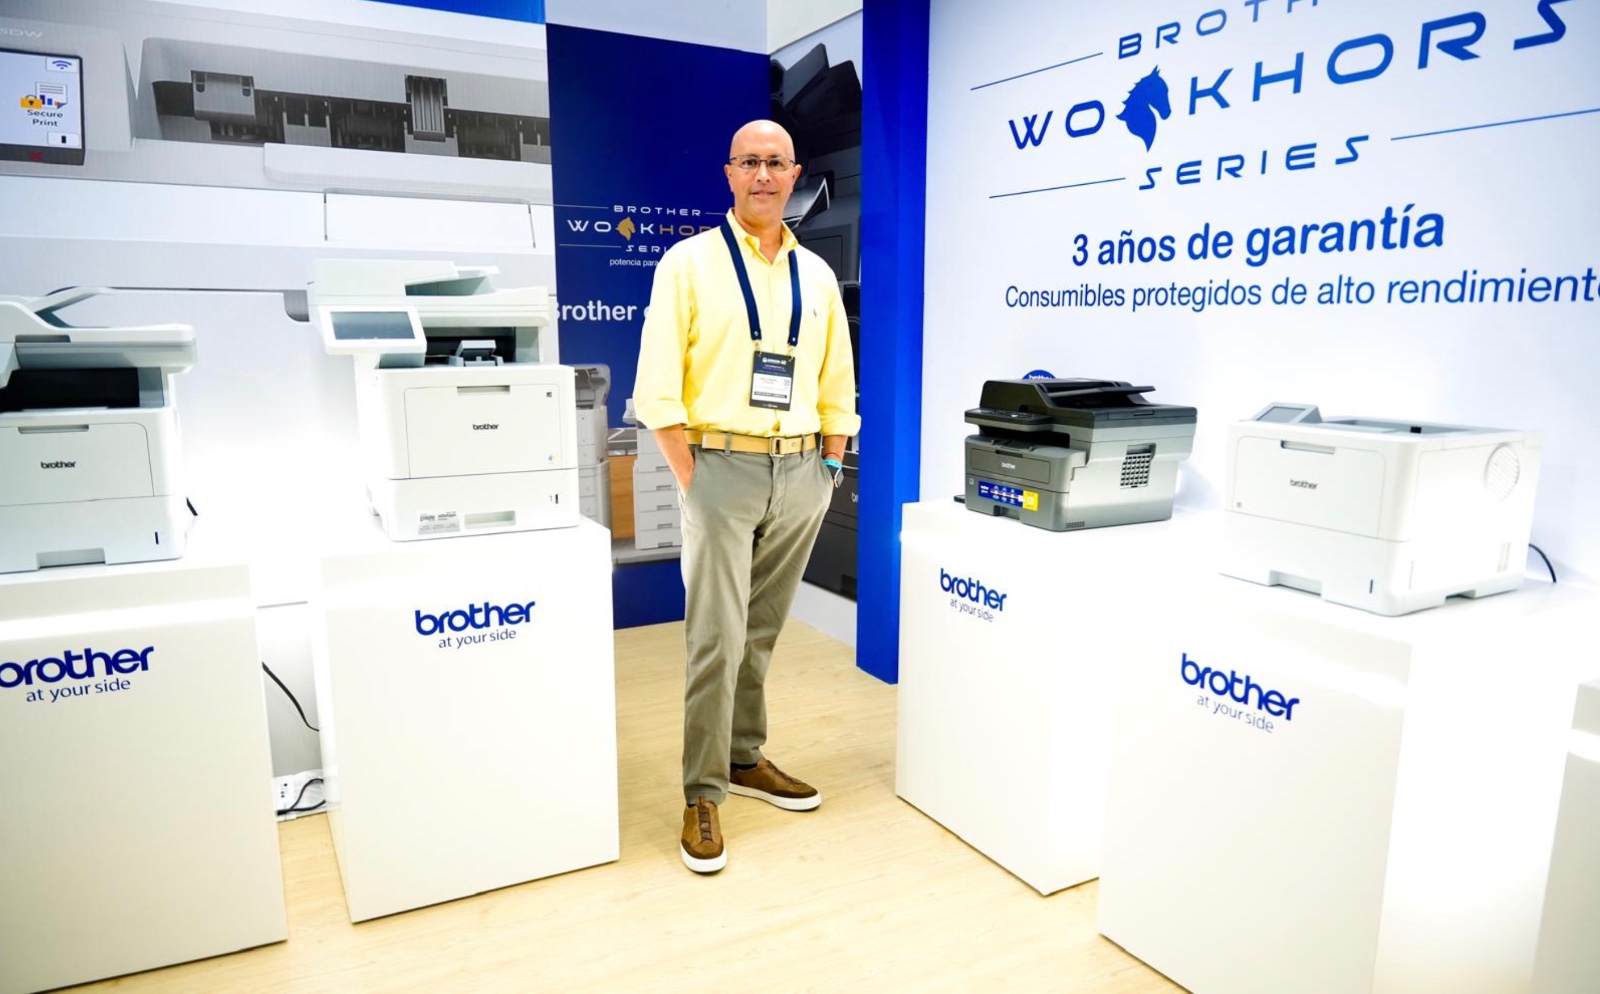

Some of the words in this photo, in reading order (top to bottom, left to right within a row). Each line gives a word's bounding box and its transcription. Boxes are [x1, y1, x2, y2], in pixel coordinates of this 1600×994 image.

[27, 109, 63, 118] Secure
[32, 118, 58, 127] Print
[1138, 134, 1369, 190] SERIES
[613, 204, 701, 216] BROTHER
[1072, 233, 1089, 267] 3
[1097, 229, 1176, 265] años
[1187, 222, 1233, 261] de
[1246, 203, 1444, 267] garantía
[609, 258, 641, 267] potencia
[1005, 283, 1125, 308] Consumibles
[1132, 279, 1262, 313] protegidos
[1271, 276, 1307, 305] de
[1317, 274, 1375, 305] alto
[472, 423, 499, 431] brother
[40, 460, 76, 469] brother
[1290, 479, 1318, 490] brother
[940, 567, 1007, 612] brother
[415, 601, 536, 636] brother
[950, 599, 958, 608] at
[959, 602, 977, 616] your
[977, 608, 993, 623] side
[438, 638, 452, 648] at
[456, 633, 487, 649] your
[490, 628, 517, 641] side
[26, 689, 44, 702] at
[50, 682, 91, 702] your
[95, 678, 131, 693] side
[1181, 652, 1300, 721] brother
[1197, 695, 1209, 708] at
[1213, 701, 1243, 720] your
[1246, 712, 1274, 734] side
